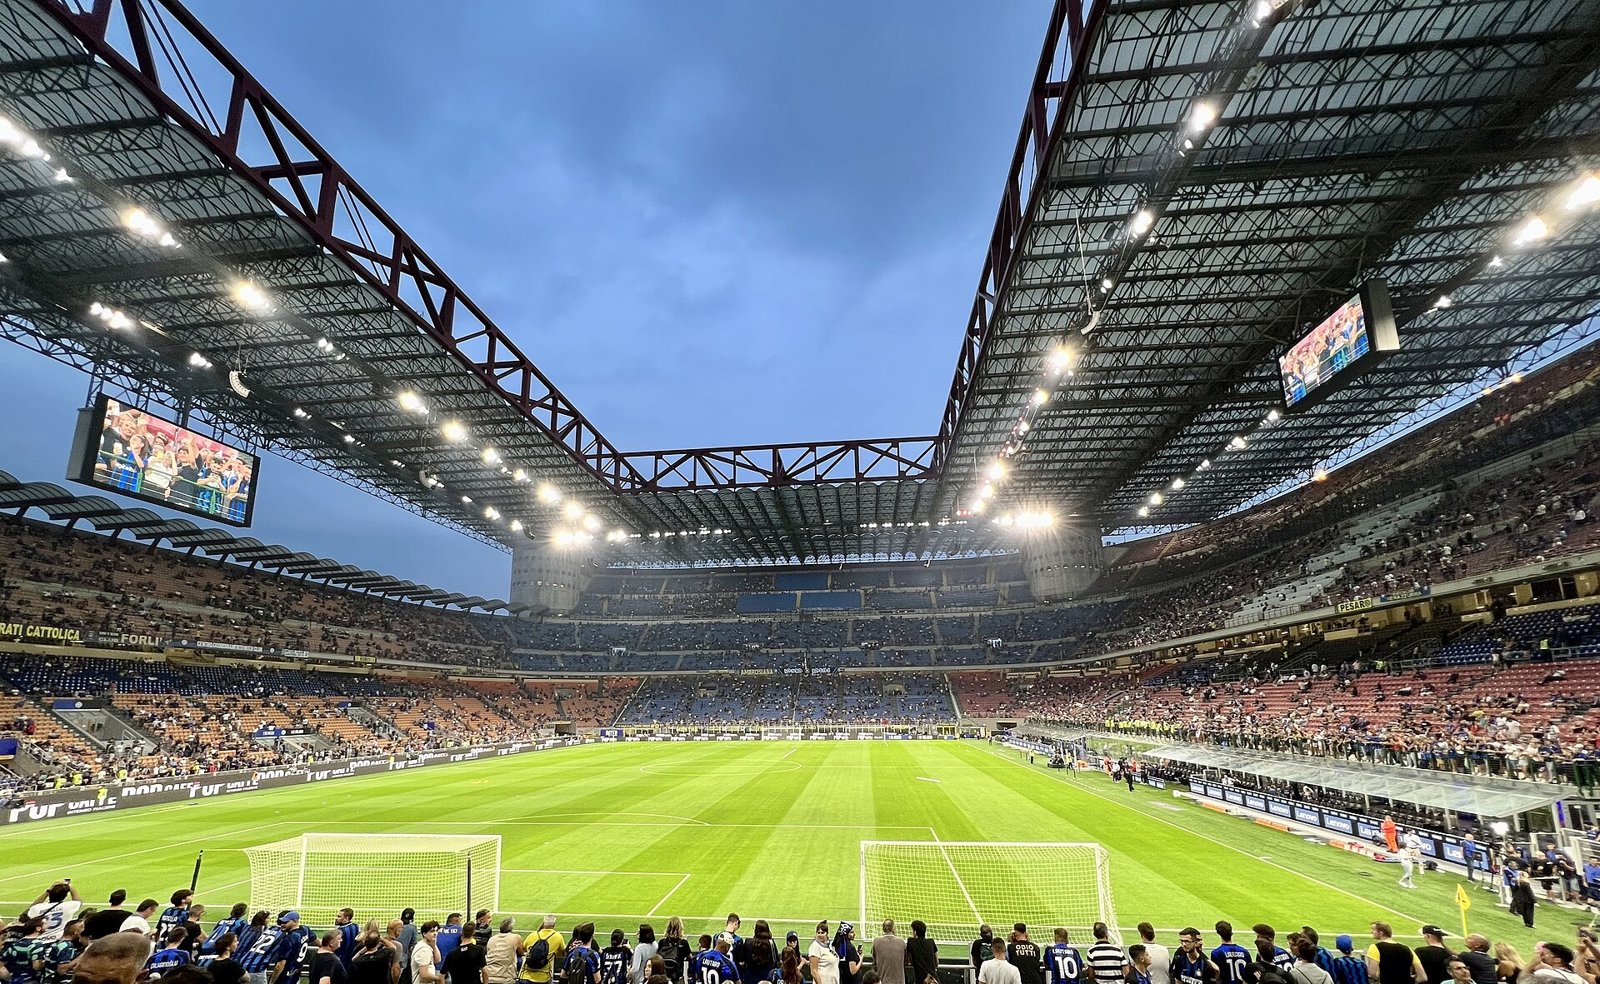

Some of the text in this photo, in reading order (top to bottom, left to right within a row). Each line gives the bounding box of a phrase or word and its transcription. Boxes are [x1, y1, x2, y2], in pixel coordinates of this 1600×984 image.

[26, 625, 80, 641] CATTOLICA
[1296, 811, 1318, 823] Lenovo
[1325, 815, 1350, 831] Lenovo
[297, 943, 308, 962] 9
[604, 960, 622, 976] 77
[701, 967, 719, 984] 10
[1055, 956, 1078, 979] 10
[1226, 959, 1247, 981] 10
